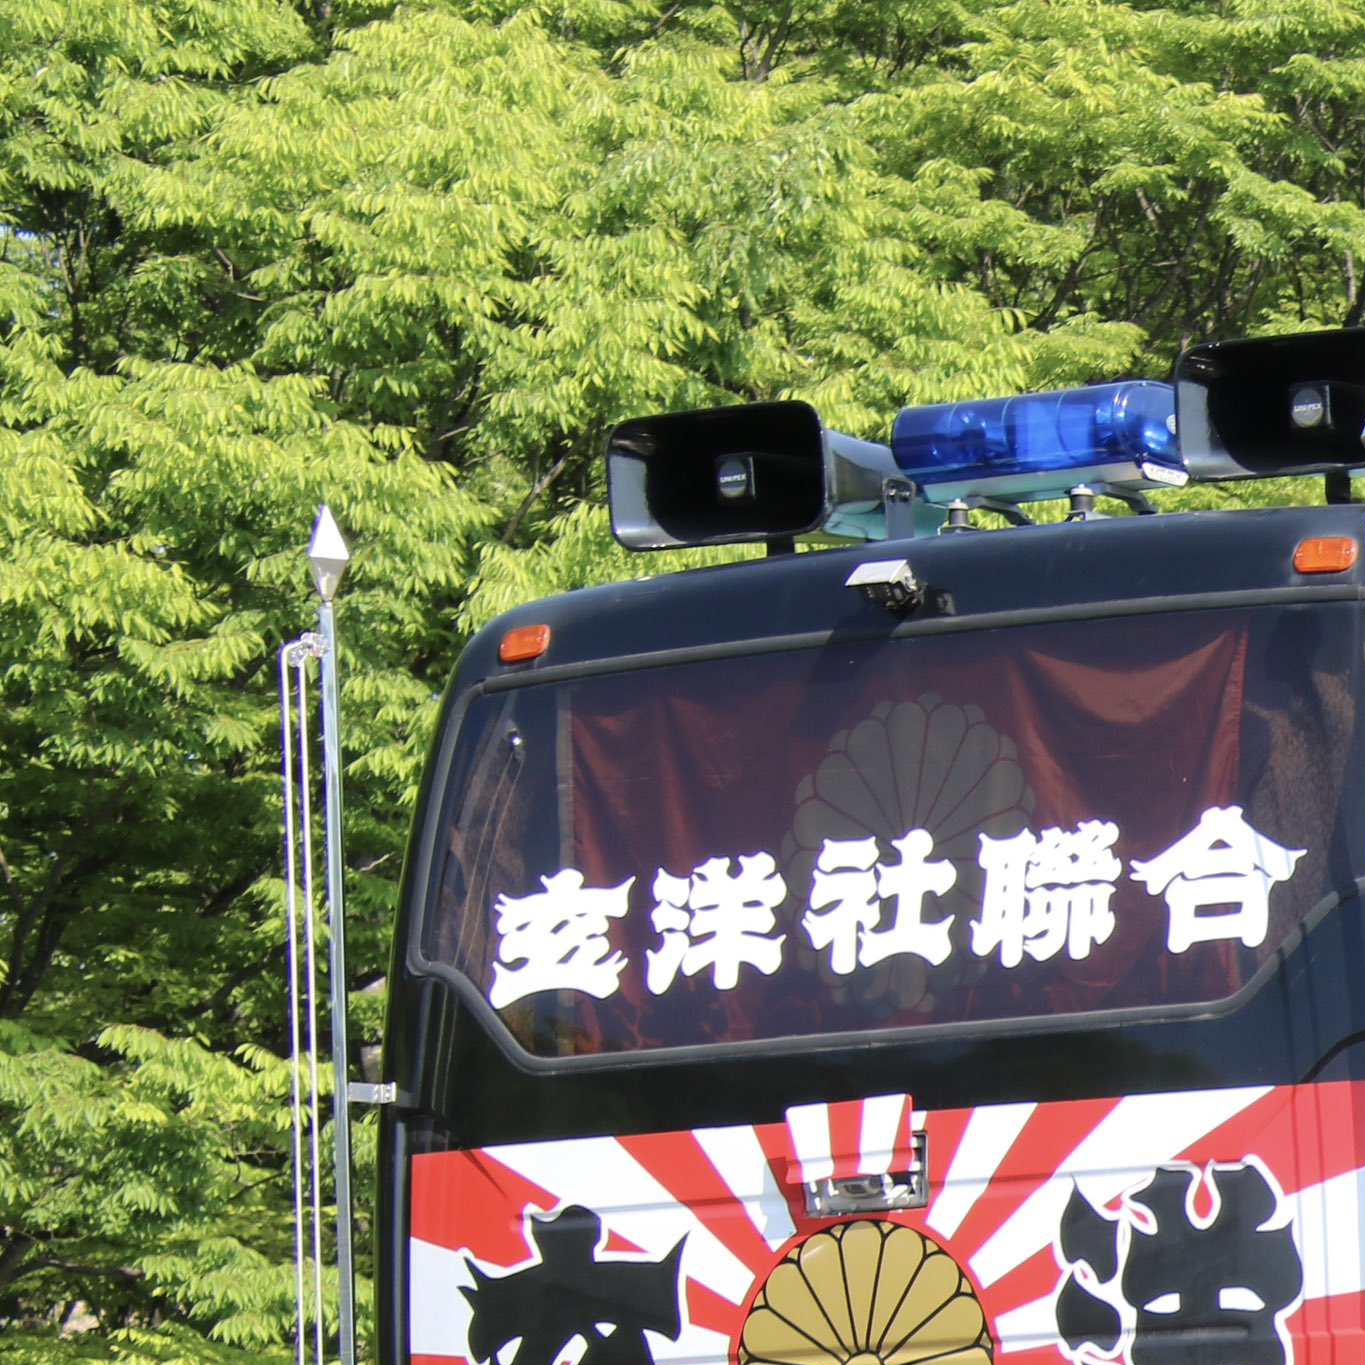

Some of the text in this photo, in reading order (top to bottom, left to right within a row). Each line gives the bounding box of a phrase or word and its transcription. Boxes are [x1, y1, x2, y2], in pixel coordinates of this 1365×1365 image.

[489, 805, 1308, 1009] 玄洋社聯合
